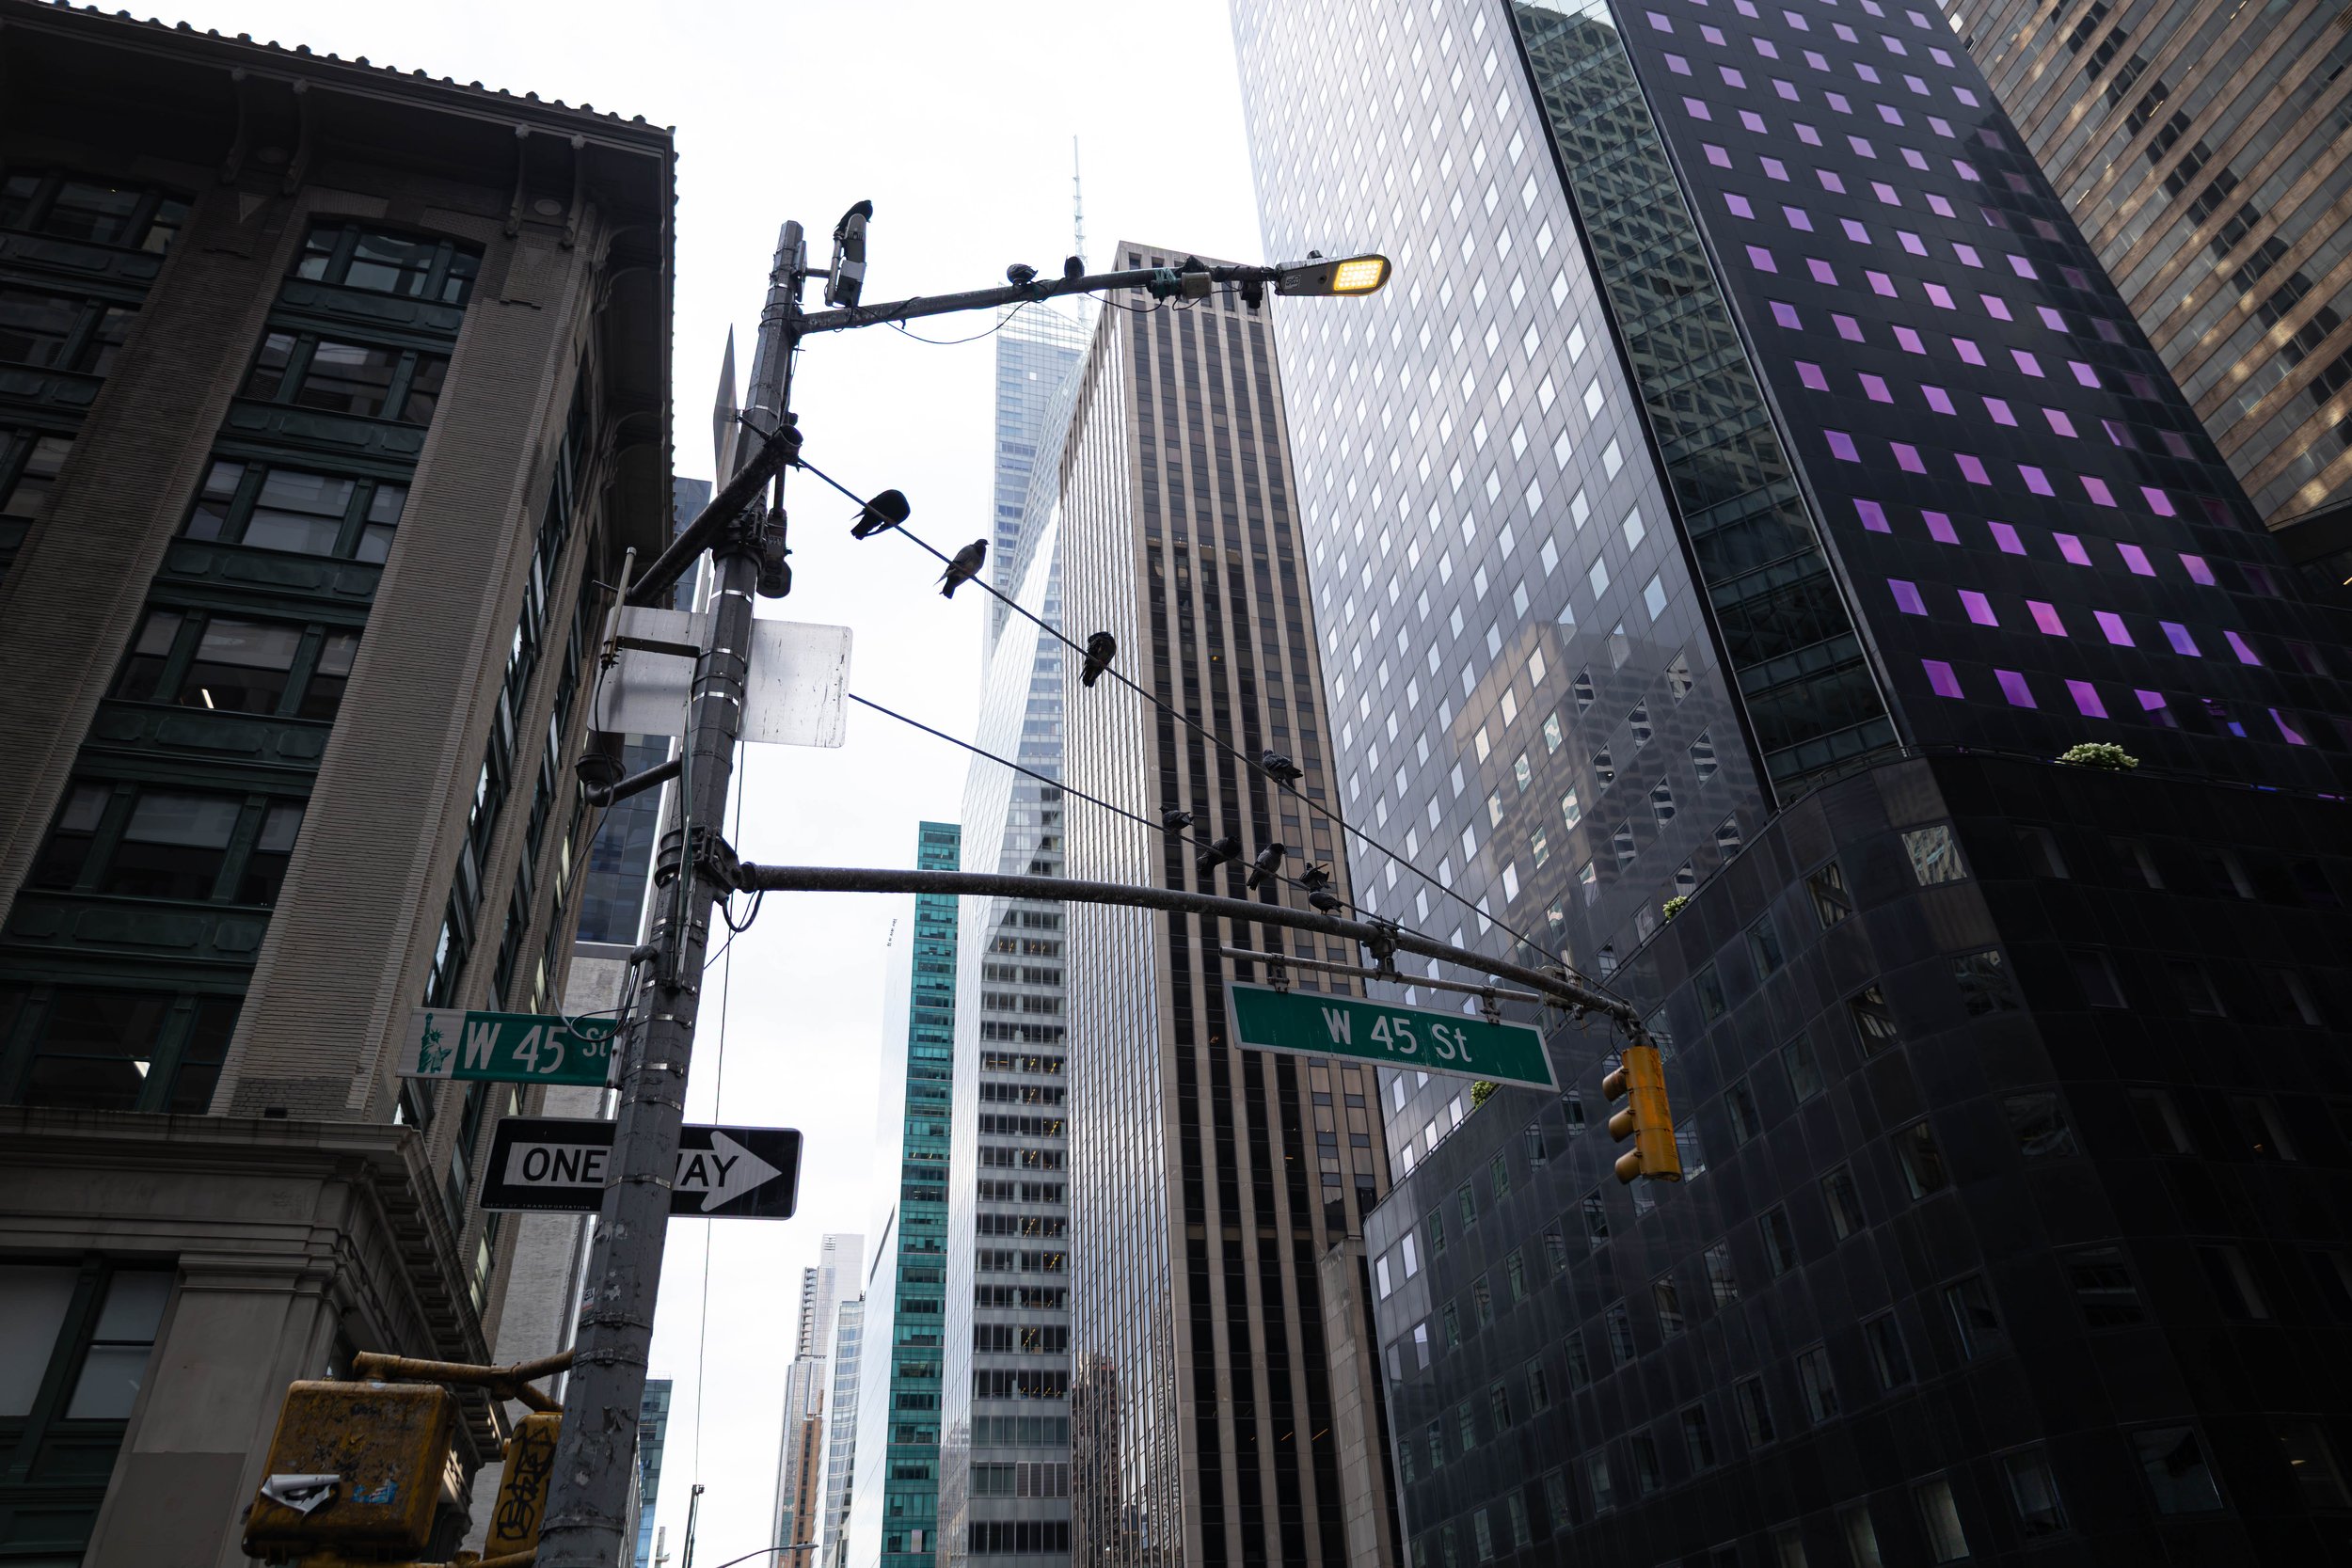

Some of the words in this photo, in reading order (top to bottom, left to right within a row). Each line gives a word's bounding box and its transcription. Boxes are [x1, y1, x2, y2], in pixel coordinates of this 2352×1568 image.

[464, 1022, 502, 1070] W
[512, 1024, 568, 1074] 45
[582, 1027, 609, 1057] St
[1321, 1006, 1352, 1045] W
[1370, 1015, 1418, 1054] 45
[1431, 1022, 1472, 1063] St
[522, 1147, 608, 1184] ONE
[675, 1152, 740, 1188] AY
